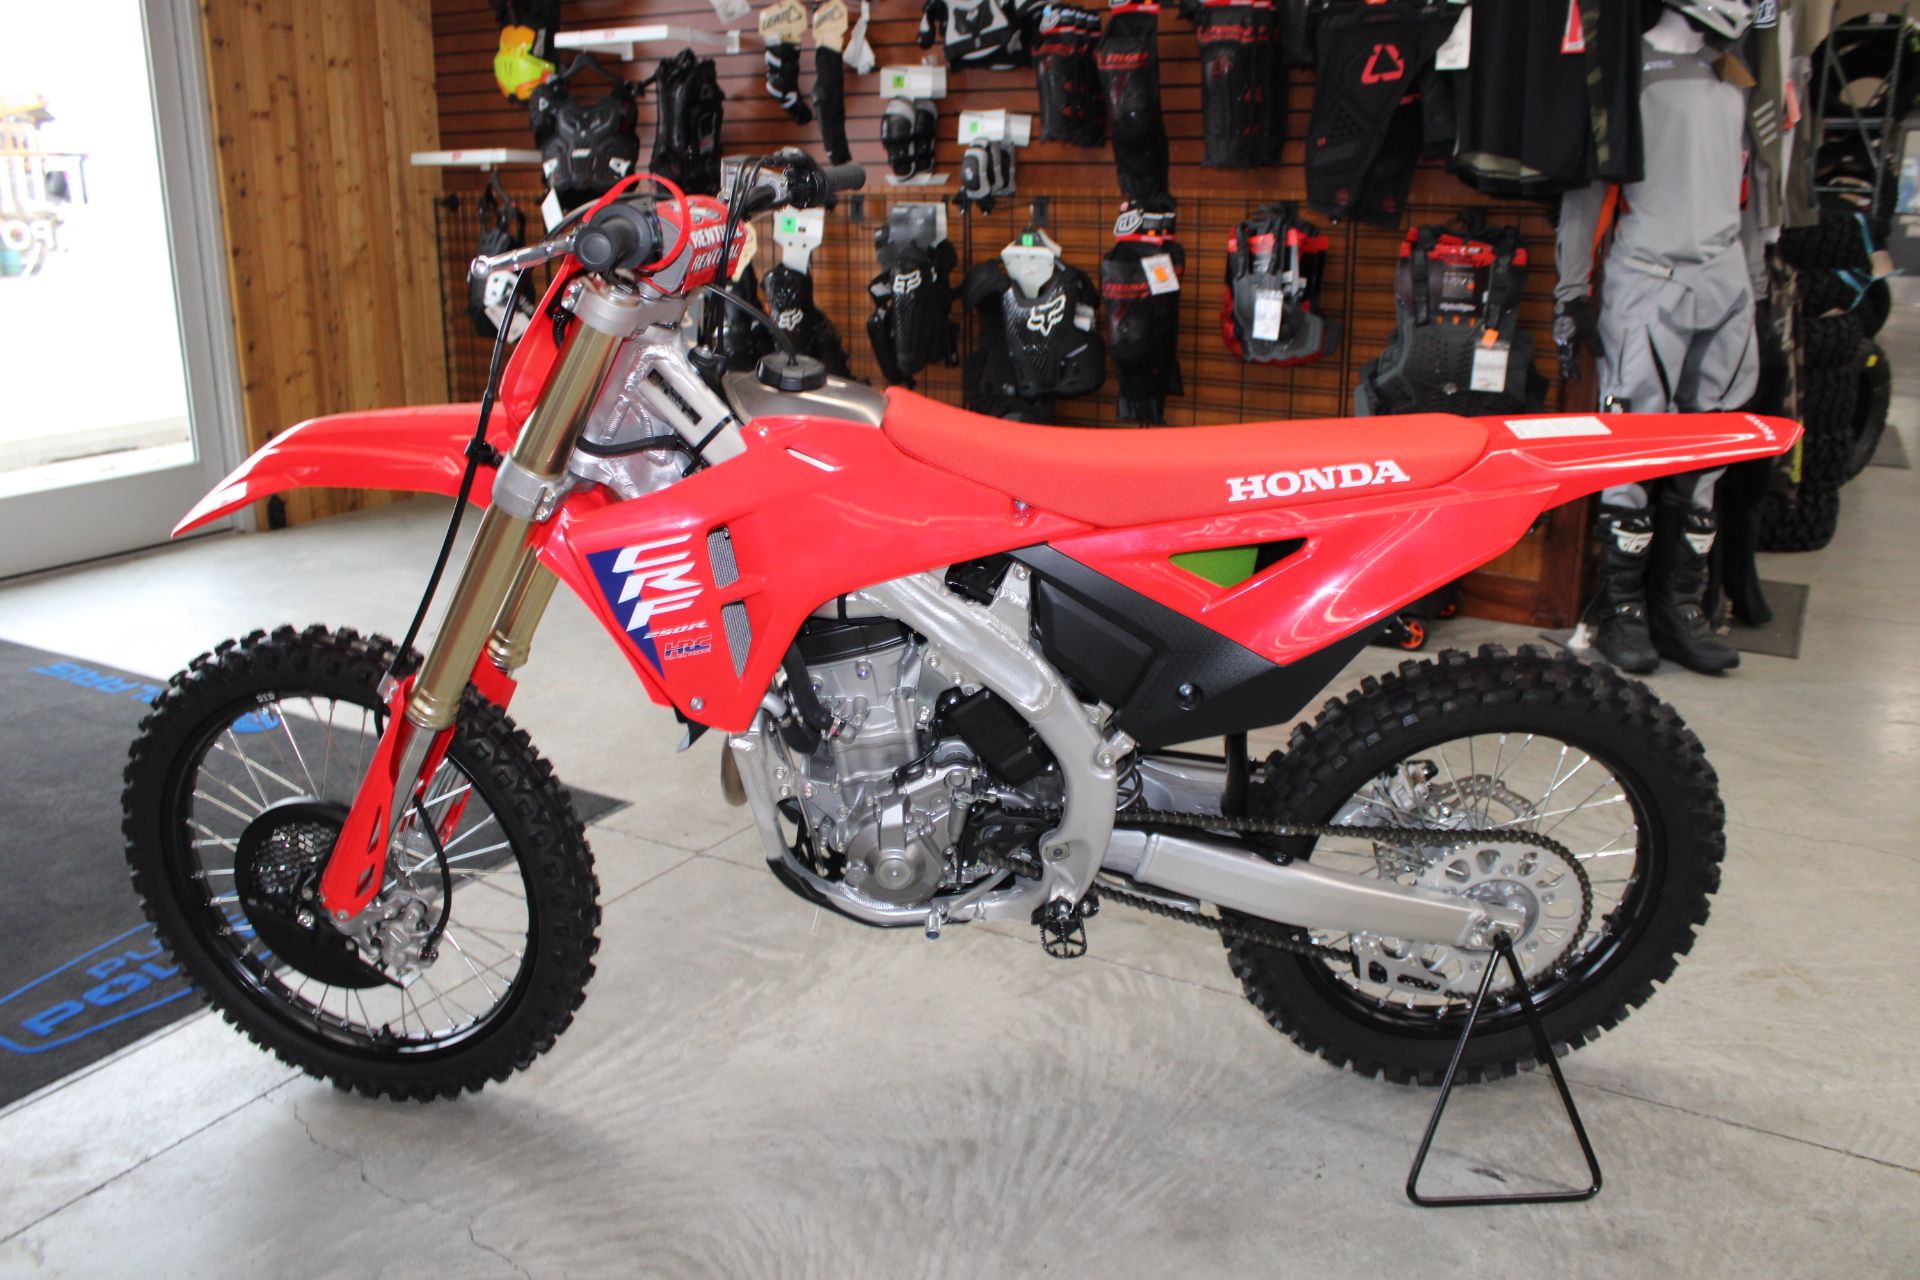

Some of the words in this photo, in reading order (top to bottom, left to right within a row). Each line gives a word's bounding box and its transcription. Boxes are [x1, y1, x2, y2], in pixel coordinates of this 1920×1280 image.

[1226, 459, 1411, 502] HONDA
[611, 531, 704, 632] CRF
[642, 620, 710, 640] 250R
[664, 634, 712, 659] HRC
